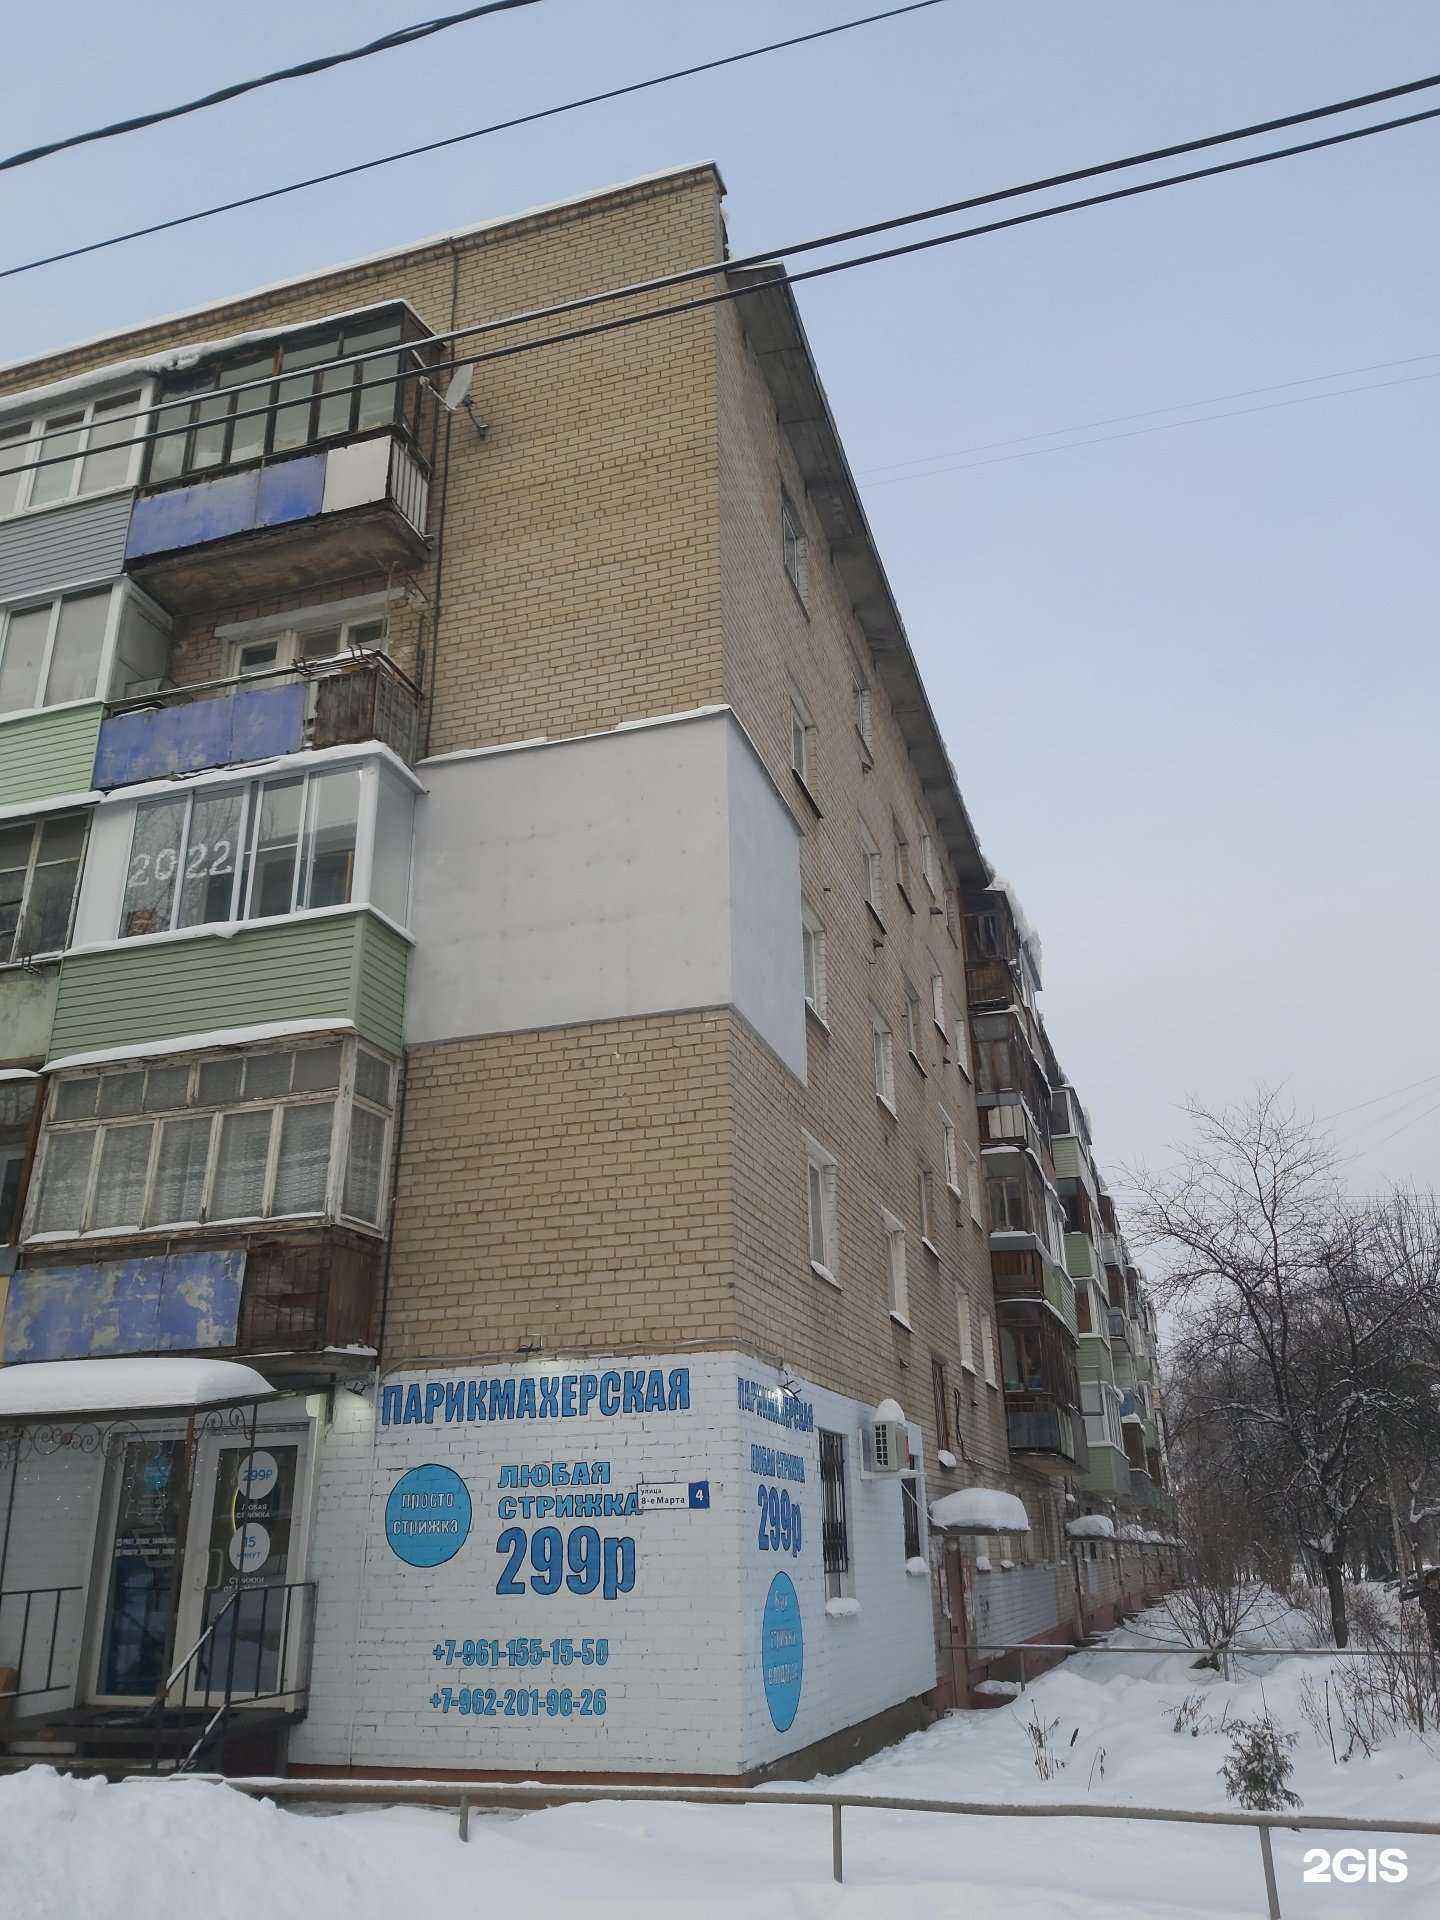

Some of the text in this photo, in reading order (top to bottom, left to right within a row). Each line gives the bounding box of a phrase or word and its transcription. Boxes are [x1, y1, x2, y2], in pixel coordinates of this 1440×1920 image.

[128, 840, 232, 887] 2022
[381, 1367, 691, 1426] ПАРИКМАХЕРСКАЯ
[497, 1461, 611, 1489] ЛЮБАЯ
[401, 1493, 455, 1510] просто
[497, 1493, 643, 1520] СТРИЖКА
[656, 1496, 686, 1506] Марта
[695, 1488, 704, 1501] 4
[392, 1519, 459, 1537] стрижка
[757, 1484, 802, 1558] 299р
[495, 1525, 637, 1600] 299р
[432, 1637, 609, 1667] +7-961-155-15-50
[429, 1687, 608, 1717] +7-962-201-96-26
